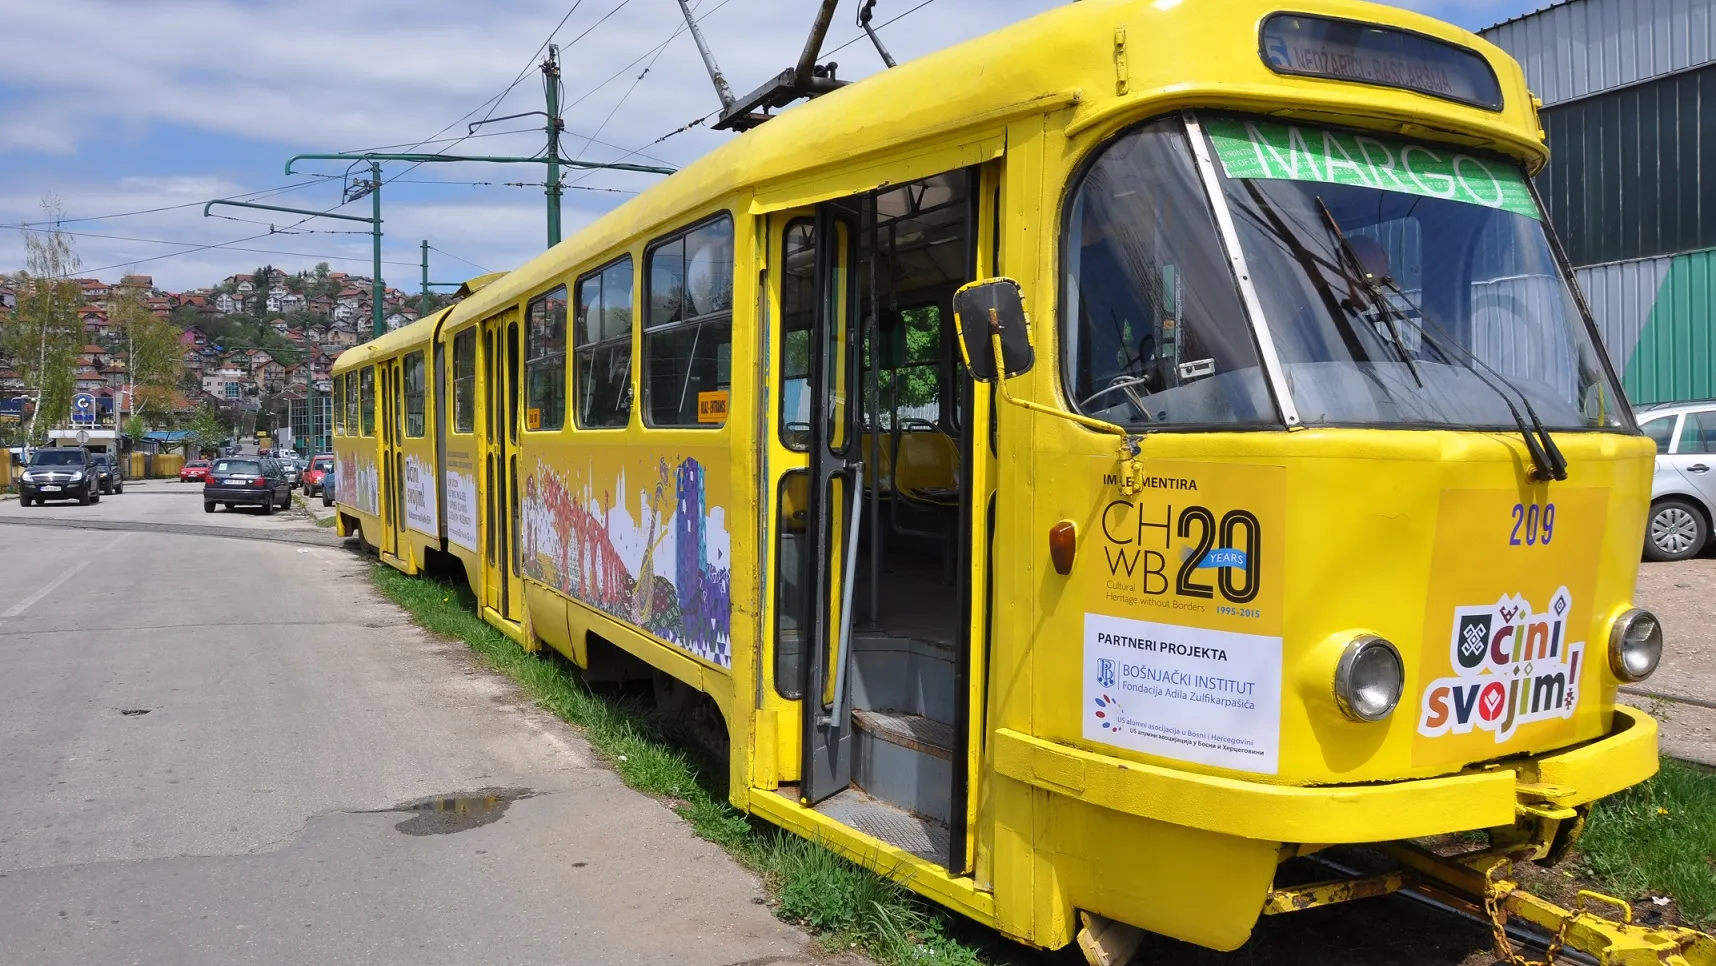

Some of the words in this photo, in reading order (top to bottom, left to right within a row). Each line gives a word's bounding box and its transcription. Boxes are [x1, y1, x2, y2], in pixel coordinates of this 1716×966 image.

[1243, 120, 1504, 208] MARGO
[1103, 474, 1198, 491] IMLEMENTIRA
[1509, 503, 1555, 546] 209
[1102, 500, 1171, 549] CH
[1176, 505, 1261, 604] 20
[1210, 554, 1244, 565] YEARS
[1104, 546, 1168, 595] WB
[1106, 580, 1136, 592] Cultural
[1106, 592, 1138, 605] Heritage
[1140, 597, 1170, 609] without
[1172, 600, 1205, 612] Borders
[1216, 605, 1261, 619] 1995-2015
[1457, 594, 1567, 668] Učini
[1097, 632, 1156, 652] PARTNERI
[1160, 642, 1228, 662] PROJEKTA
[1123, 664, 1191, 686] BOŠNJAČKI
[1195, 675, 1256, 695] INSTITUT
[1425, 650, 1579, 734] svojim!
[1122, 681, 1163, 697] Fondacija
[1164, 688, 1188, 700] Adila
[1189, 691, 1256, 710] Zulfikarpašića
[1126, 718, 1147, 728] alumni
[1148, 722, 1180, 736] asocijacija
[1187, 729, 1206, 739] Bosni
[1211, 733, 1254, 746] Hercegovini
